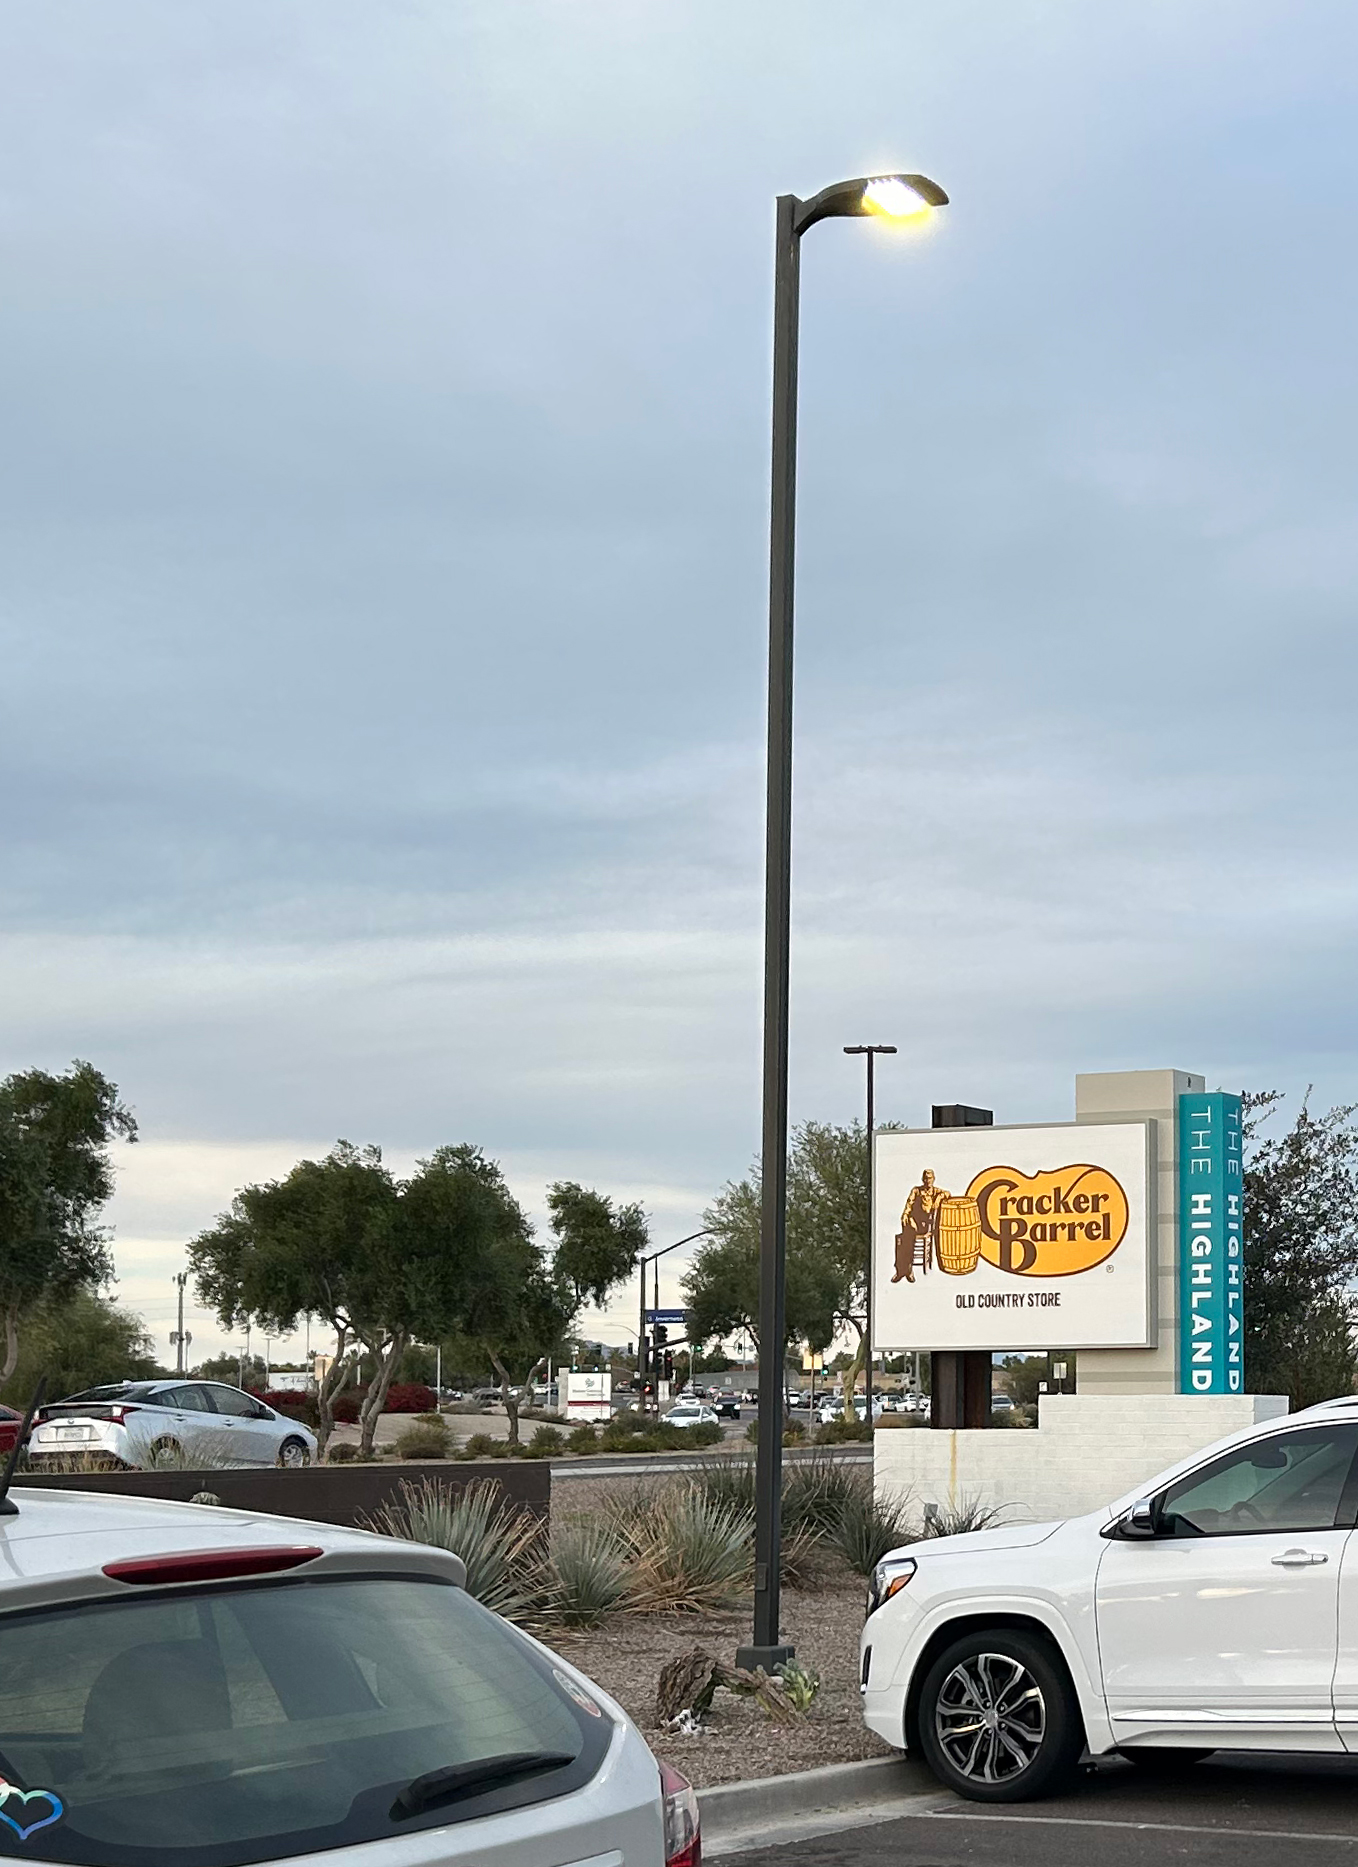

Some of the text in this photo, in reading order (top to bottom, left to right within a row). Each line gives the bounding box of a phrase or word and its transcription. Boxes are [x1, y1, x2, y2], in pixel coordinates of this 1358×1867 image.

[976, 1179, 1110, 1241] Cracker
[998, 1212, 1112, 1272] Barrel
[1191, 1106, 1213, 1391] THE HIGHLAND
[1227, 1108, 1240, 1391] THE HIGHLAND
[955, 1292, 1061, 1308] OLD COUNTRY STORE
